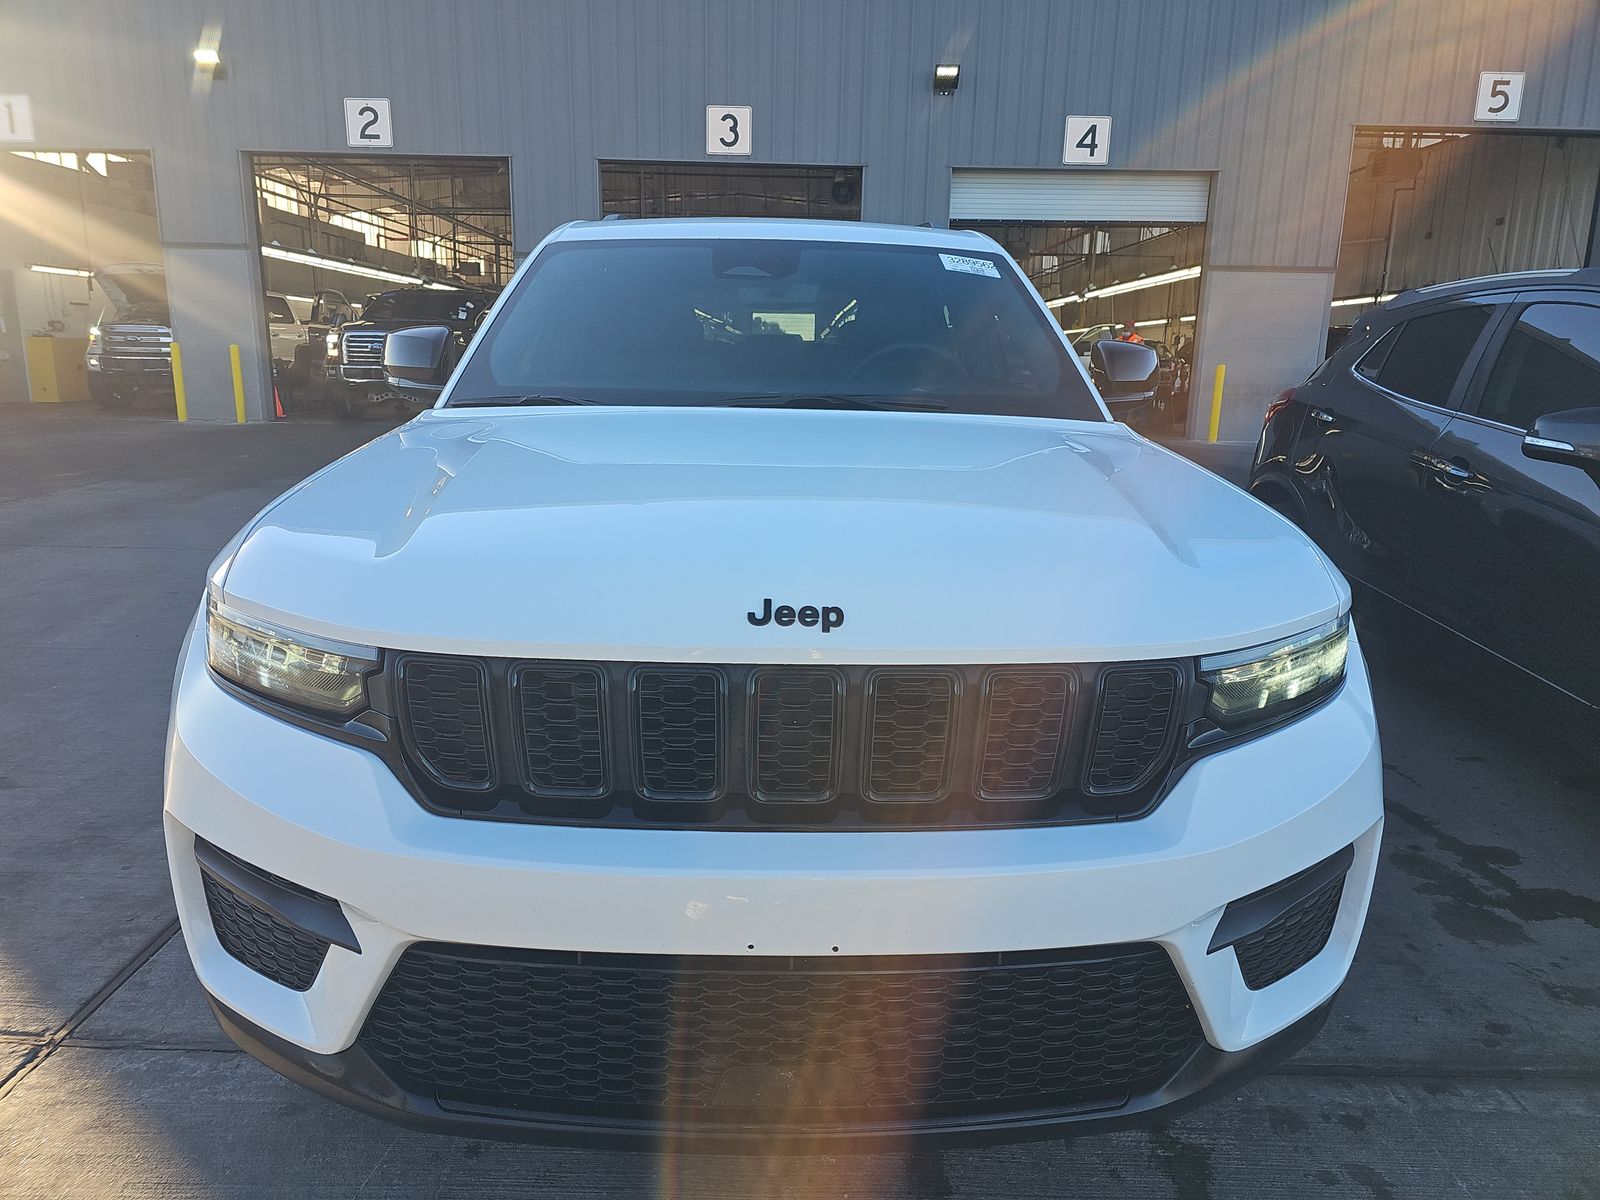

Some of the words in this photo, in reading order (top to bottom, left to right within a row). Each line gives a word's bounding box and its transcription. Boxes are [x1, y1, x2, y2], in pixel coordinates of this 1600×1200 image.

[1487, 79, 1511, 114] 5
[3, 101, 16, 134] 1
[358, 106, 381, 140] 2
[719, 113, 740, 148] 3
[1075, 124, 1099, 157] 4
[747, 598, 845, 633] Jeep
